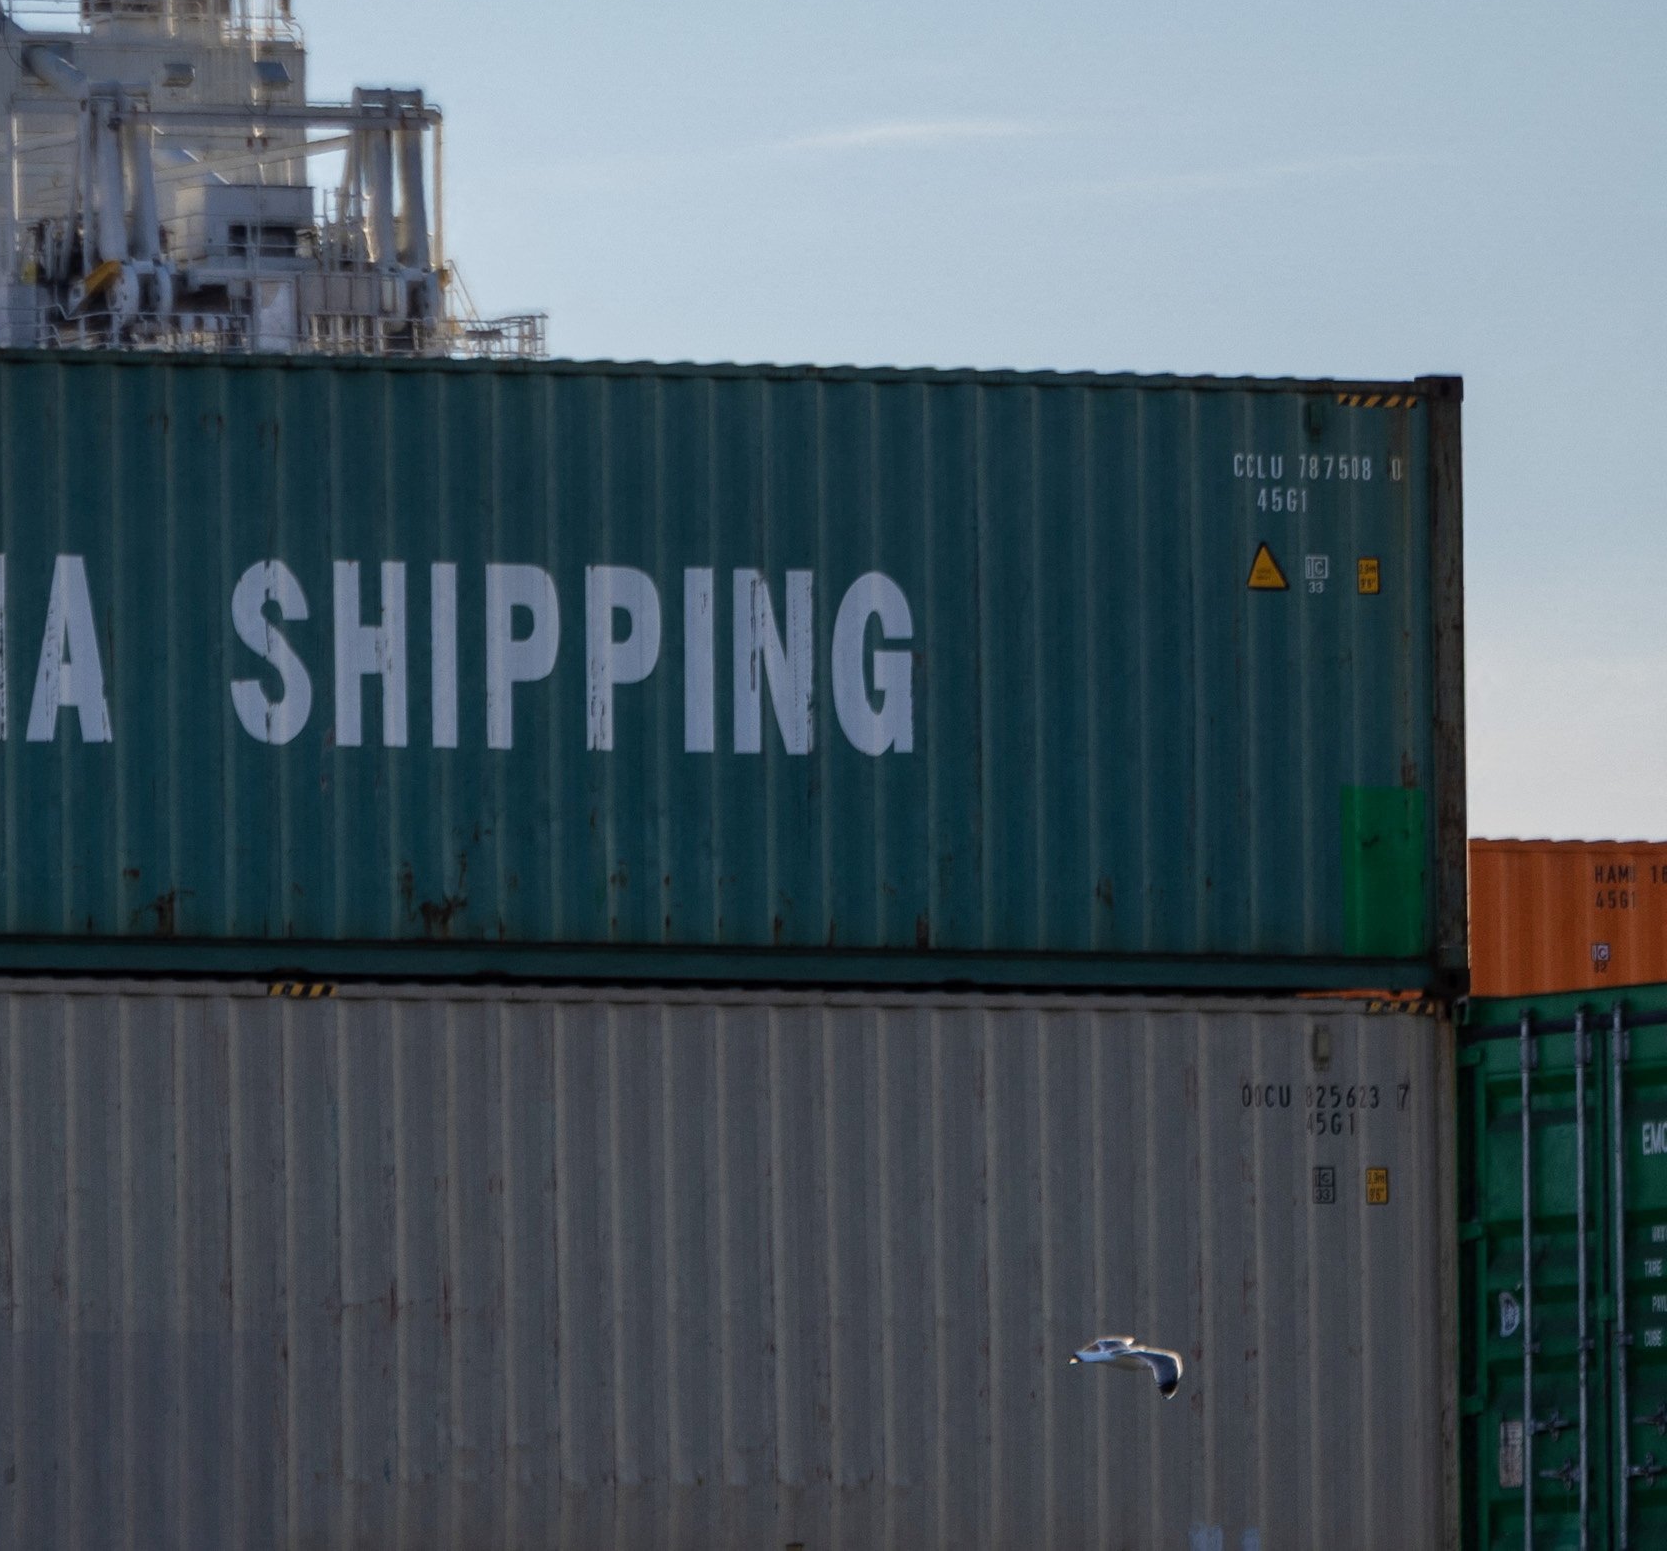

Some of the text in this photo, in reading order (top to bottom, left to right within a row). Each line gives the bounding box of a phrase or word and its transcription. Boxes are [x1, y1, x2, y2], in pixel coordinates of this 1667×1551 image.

[1233, 451, 1284, 481] CCLU
[1298, 450, 1373, 481] 787508
[1256, 486, 1308, 514] 45G1
[229, 559, 914, 758] SHIPPING
[1241, 1083, 1291, 1109] OOCU
[1305, 1085, 1380, 1110] 825623
[1307, 1112, 1354, 1136] 45G1
